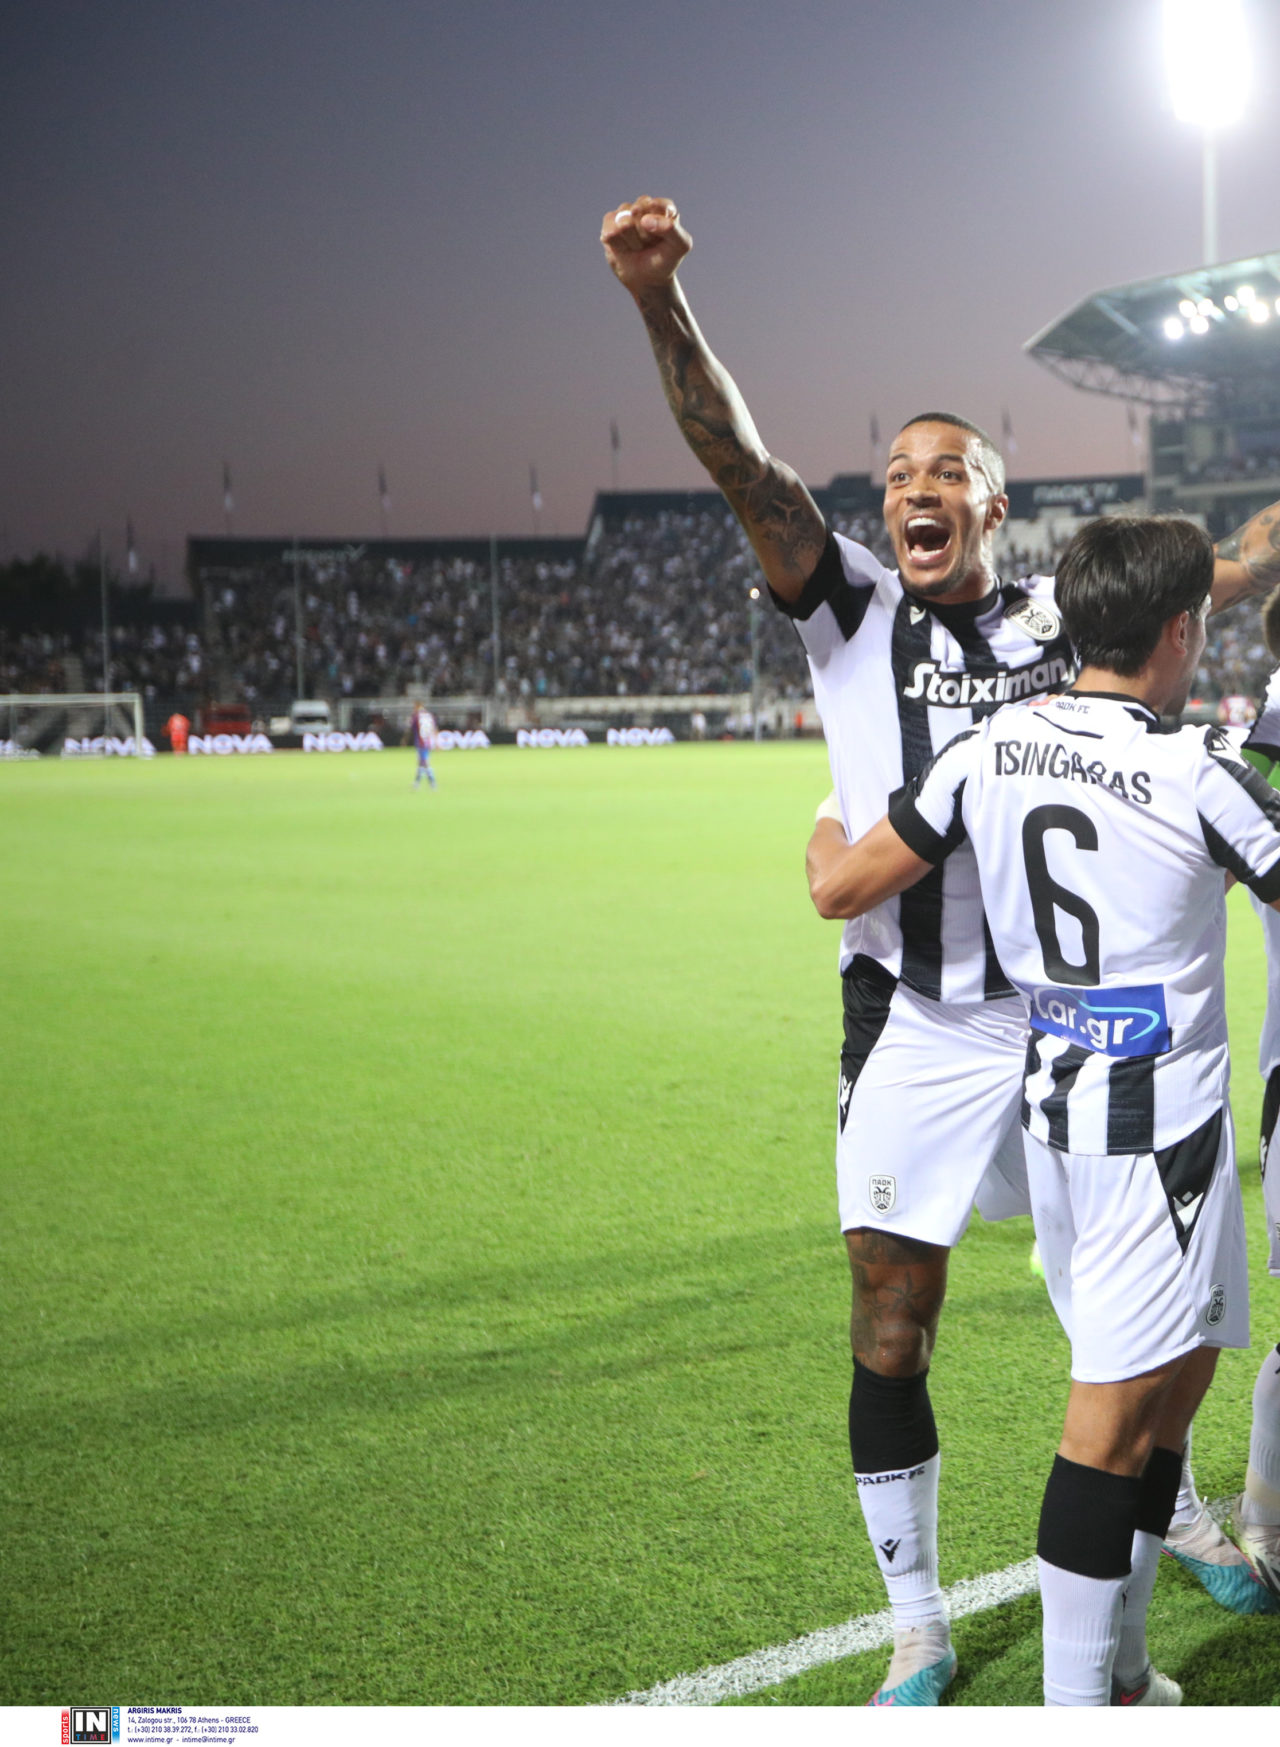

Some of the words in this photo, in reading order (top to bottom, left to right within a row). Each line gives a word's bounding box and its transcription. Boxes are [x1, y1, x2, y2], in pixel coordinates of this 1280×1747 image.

[904, 657, 1069, 705] Stoiximan
[188, 733, 273, 755] NOVA
[303, 731, 383, 752] NOVA
[516, 728, 589, 747] NOVA
[607, 727, 675, 746] NOVA
[995, 739, 1152, 805] TSINGARAS
[1023, 804, 1100, 986] 6
[855, 1472, 906, 1486] PAOK
